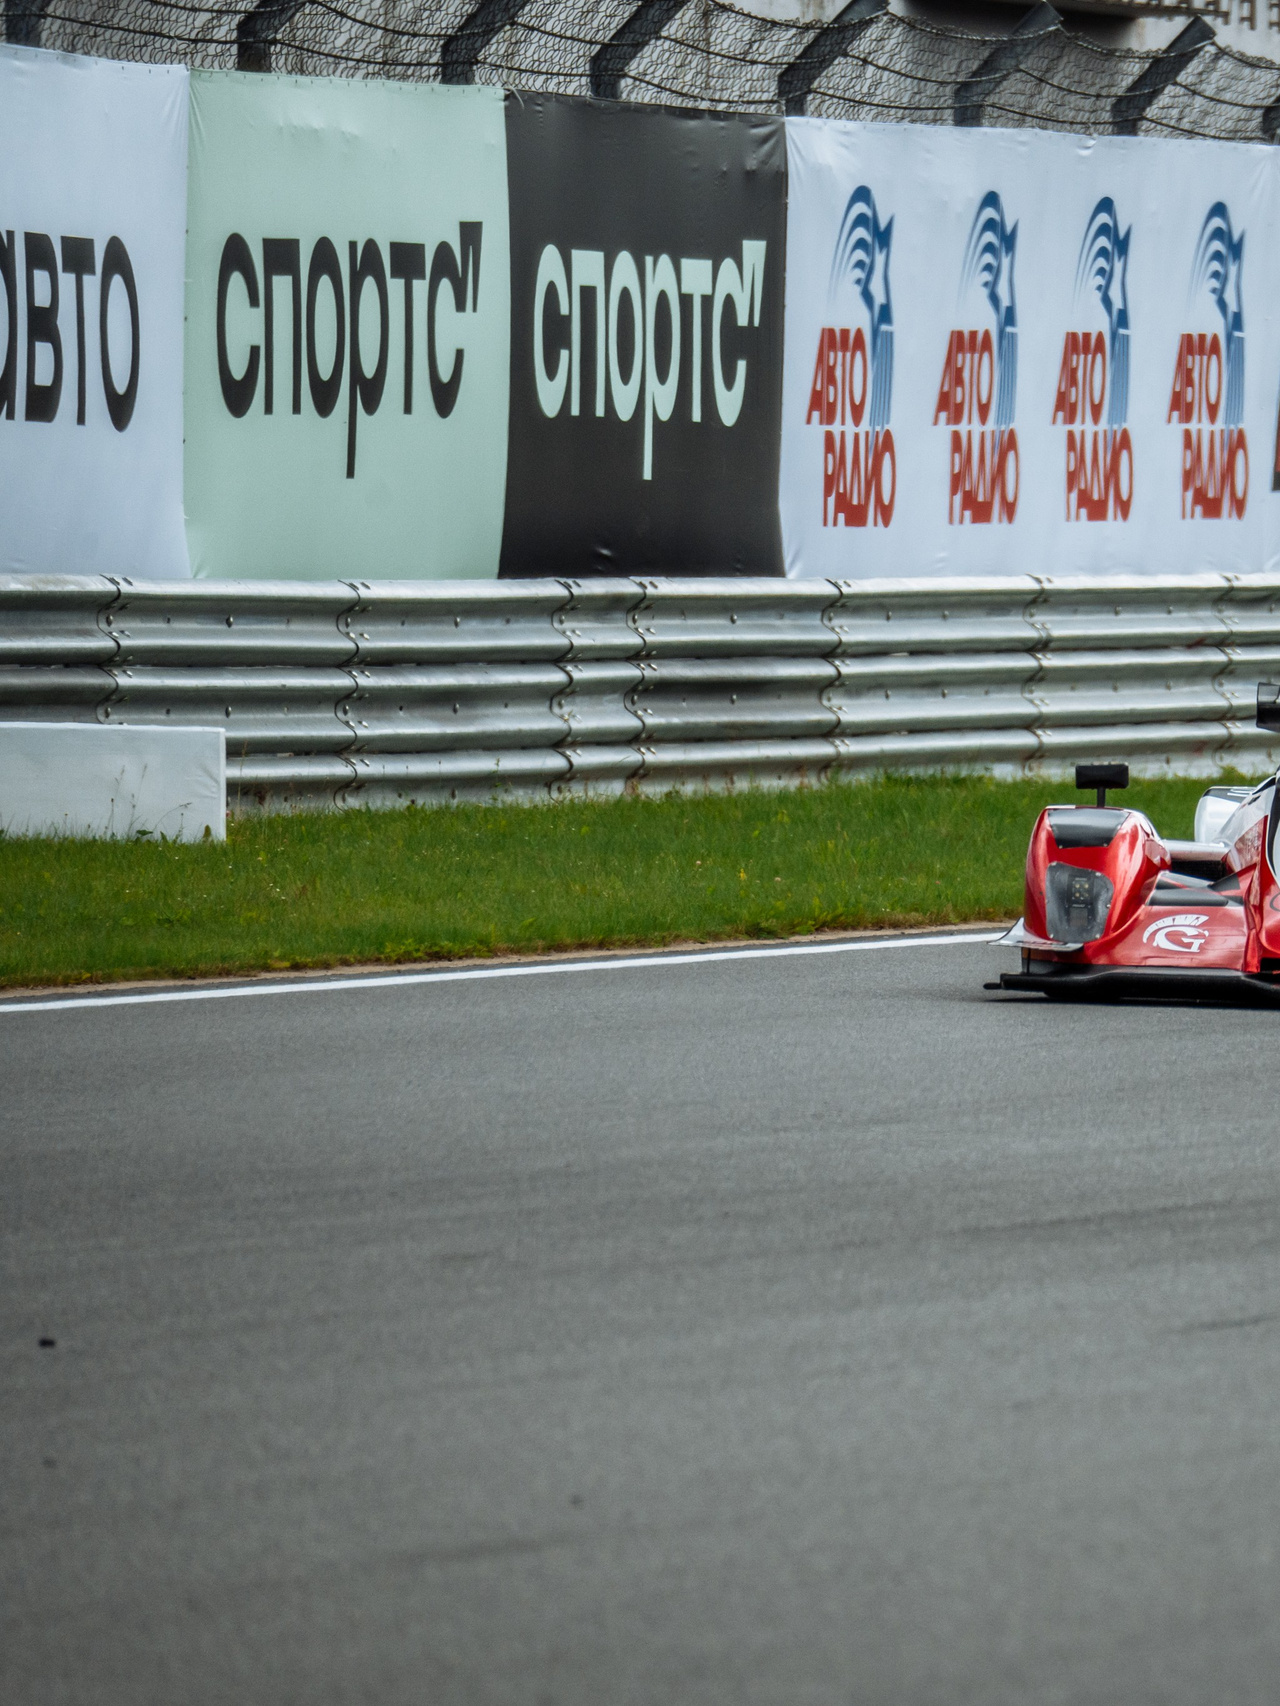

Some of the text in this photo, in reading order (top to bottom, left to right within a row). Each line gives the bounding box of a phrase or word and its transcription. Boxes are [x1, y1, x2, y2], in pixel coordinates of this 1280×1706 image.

[806, 327, 867, 427] АВТО
[933, 328, 993, 426] АВТО
[1053, 331, 1106, 425] АВТО
[1168, 333, 1221, 424] АВТО
[823, 428, 896, 528] РАДИО
[949, 428, 1018, 524] РАДИО
[1065, 428, 1133, 522] РАДИО
[1181, 428, 1247, 520] РАДИО
